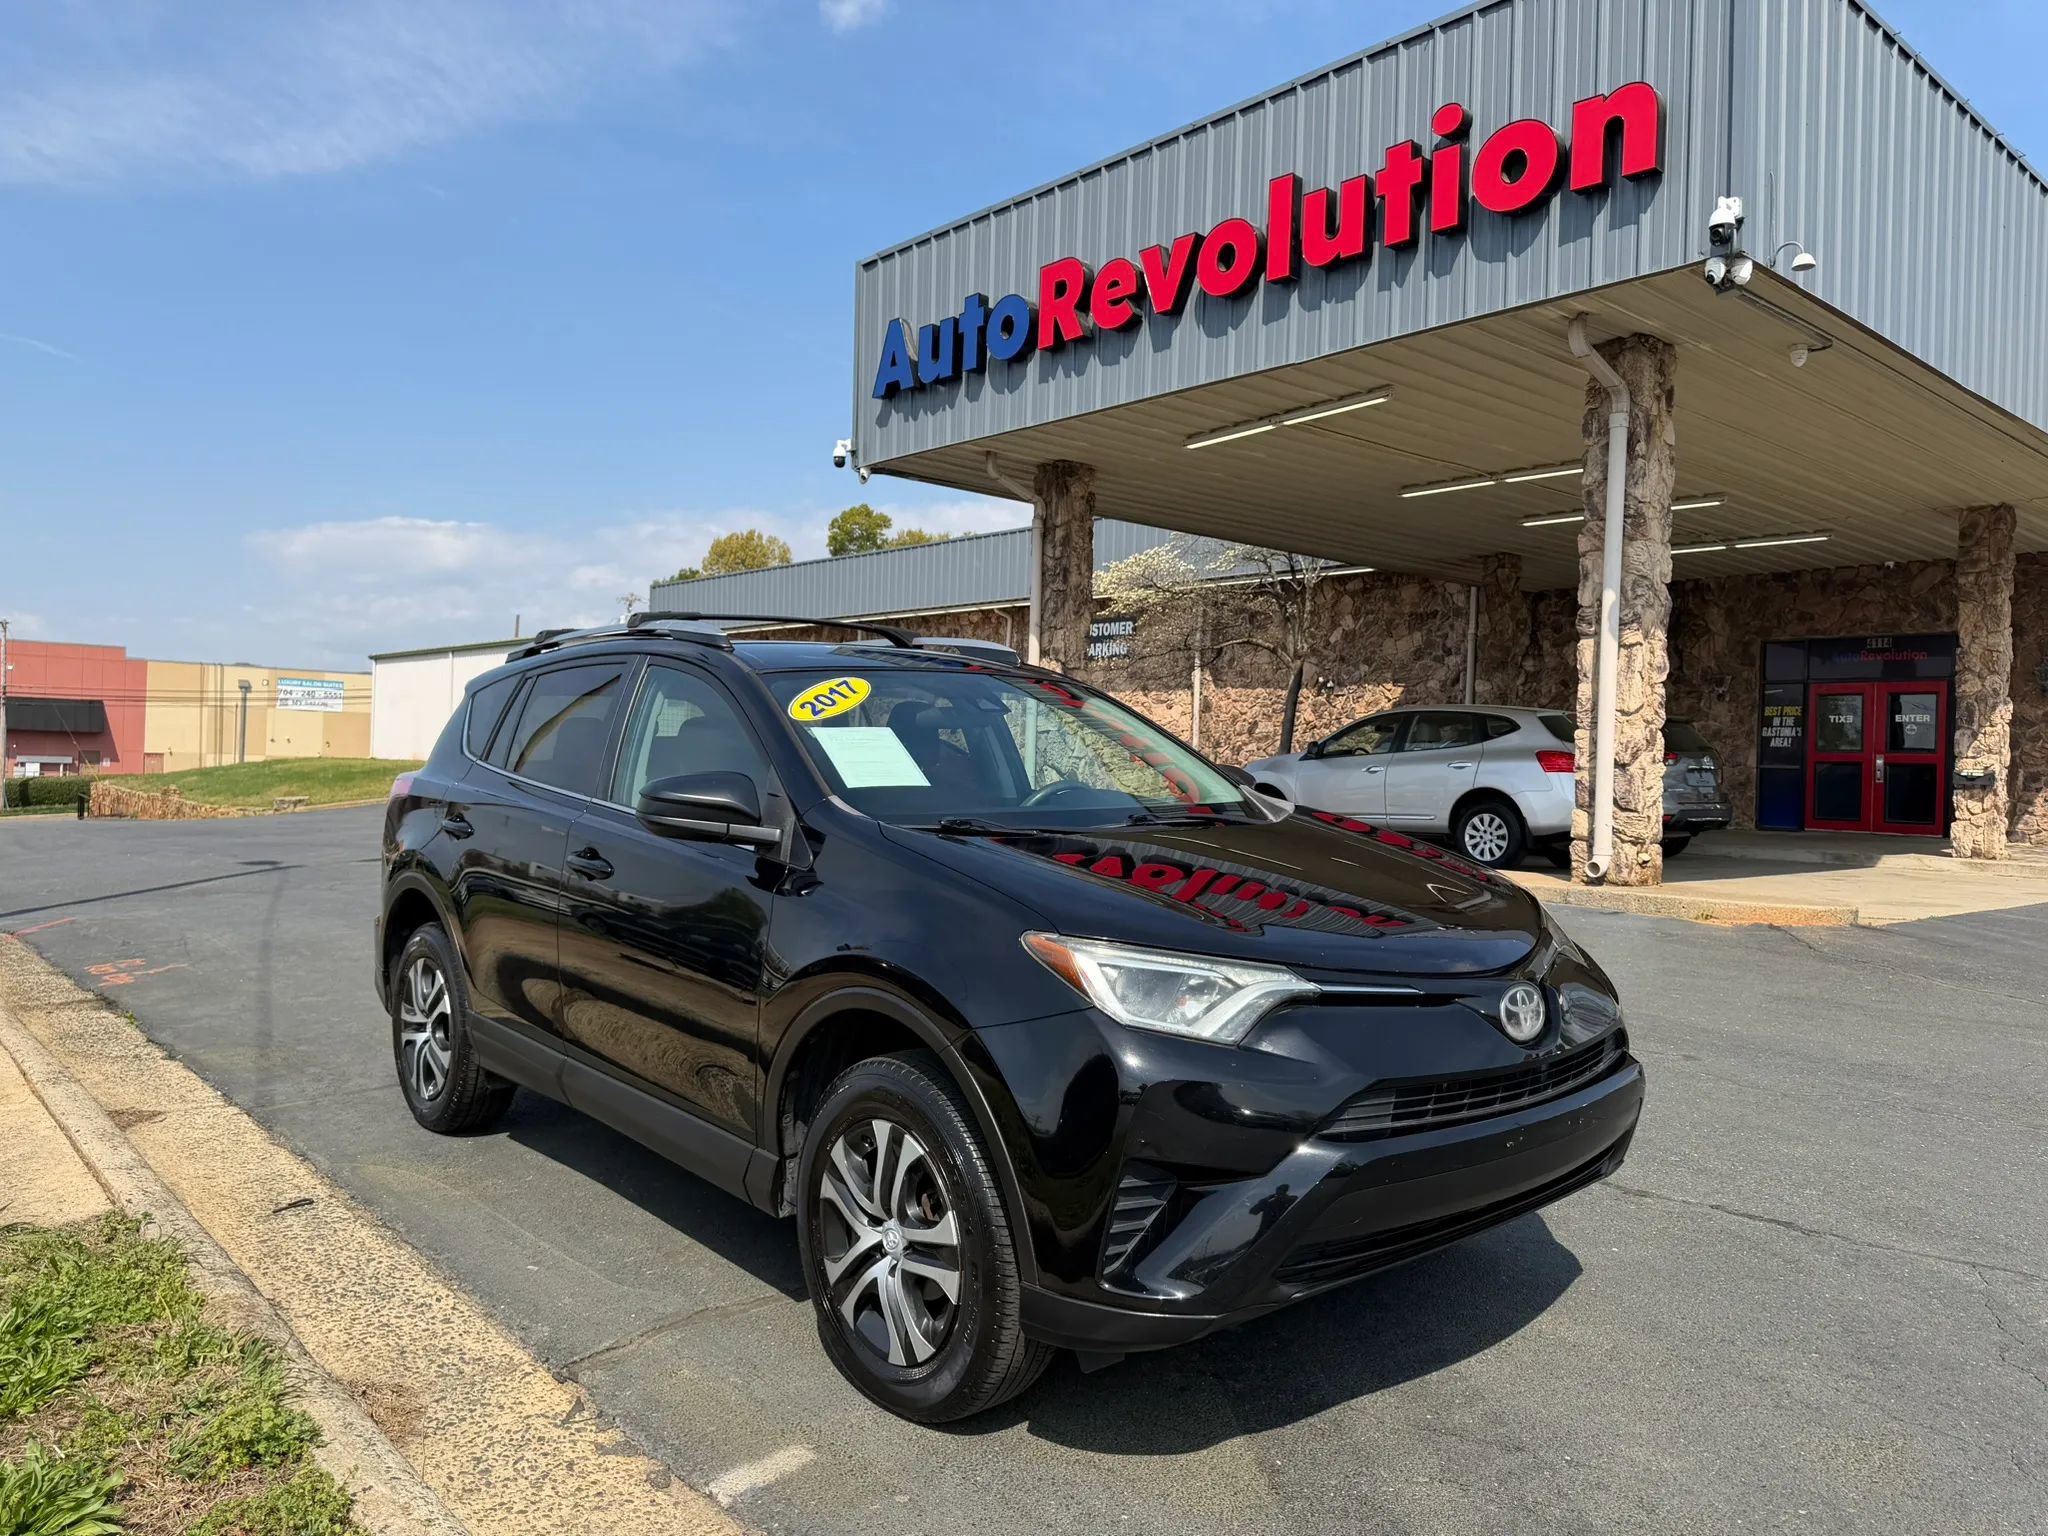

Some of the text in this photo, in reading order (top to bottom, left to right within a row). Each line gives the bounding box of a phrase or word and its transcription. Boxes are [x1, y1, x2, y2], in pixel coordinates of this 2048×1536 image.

[872, 81, 1664, 398] AutoRevolution
[1087, 642, 1127, 657] ARKING
[799, 680, 859, 717] 2017
[1764, 706, 1803, 716] BEST PRICE
[1772, 717, 1796, 726] IN THE
[1895, 714, 1930, 723] ENTER
[1762, 727, 1802, 736] GASTONIA'S
[1769, 737, 1792, 747] AREA!
